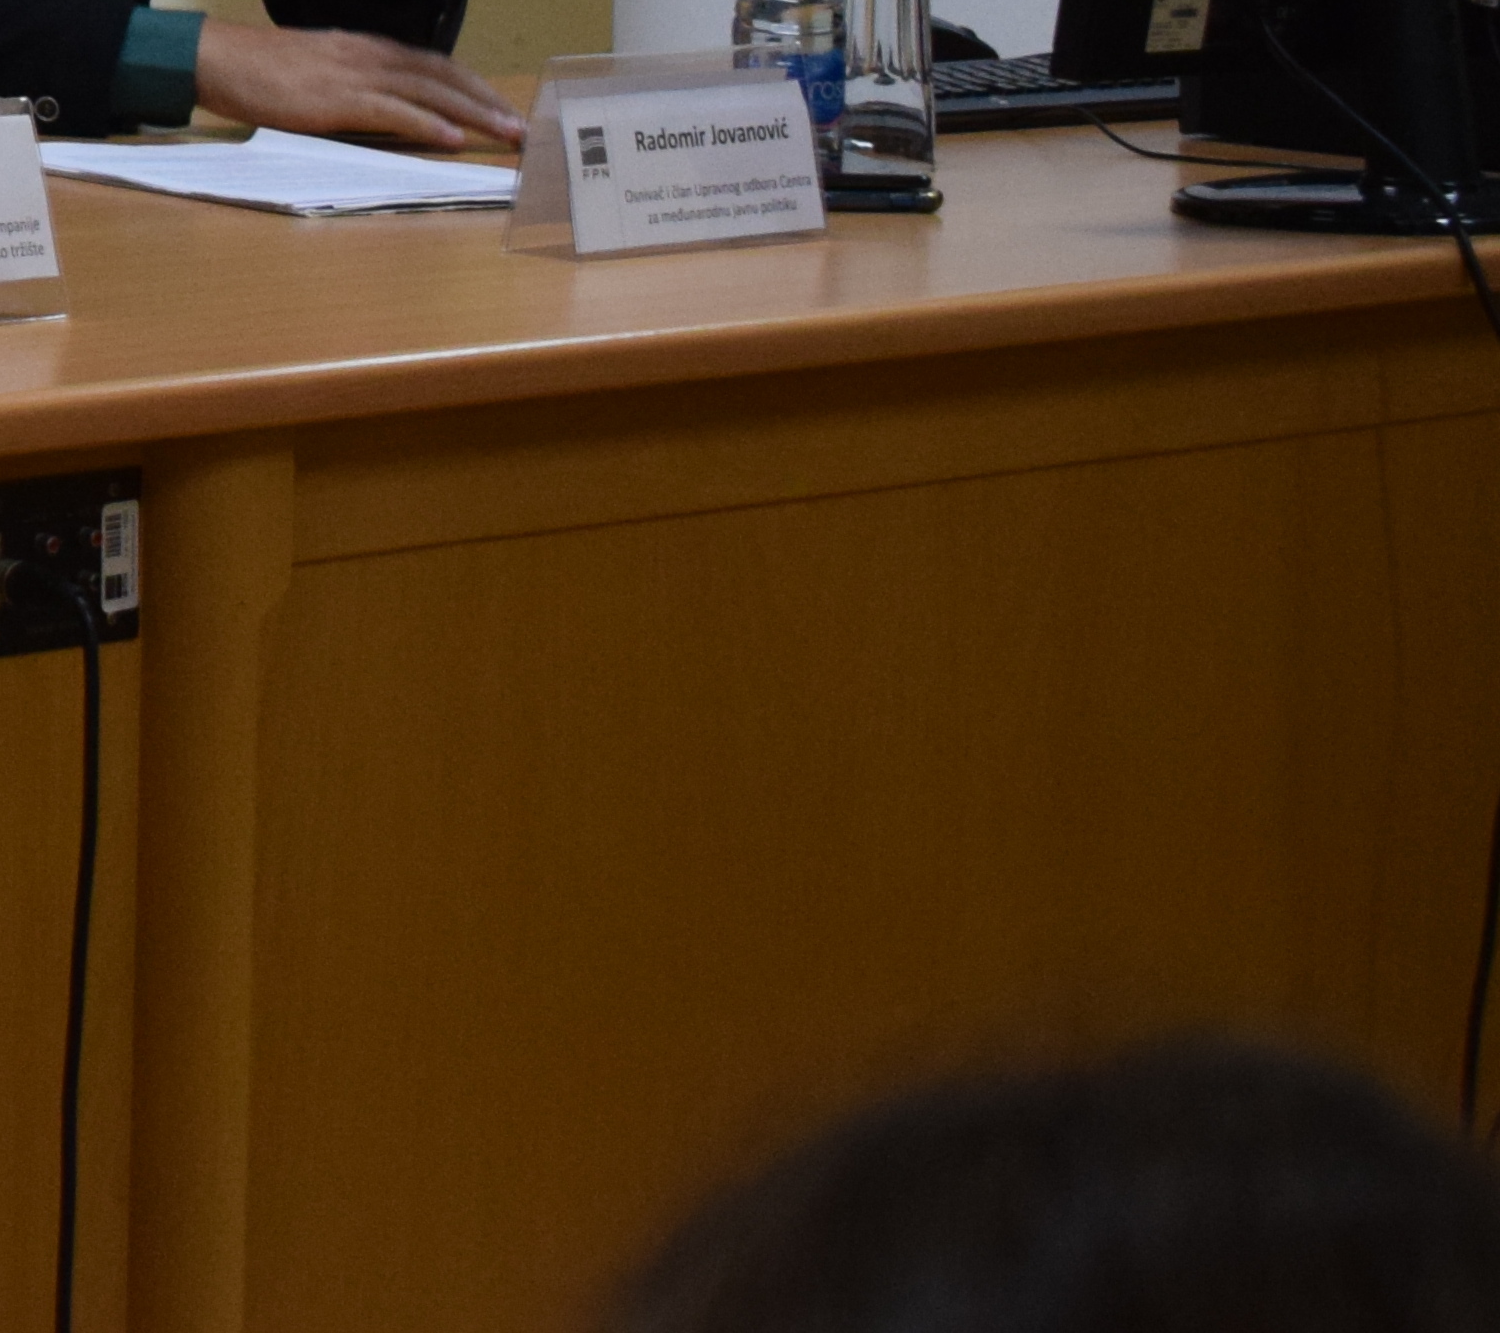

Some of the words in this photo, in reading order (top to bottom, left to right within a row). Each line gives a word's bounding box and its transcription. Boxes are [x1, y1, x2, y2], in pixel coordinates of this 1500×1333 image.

[635, 125, 704, 151] Radomir
[711, 117, 788, 145] Jovanović
[582, 169, 610, 179] FPN
[10, 241, 44, 258] tržište
